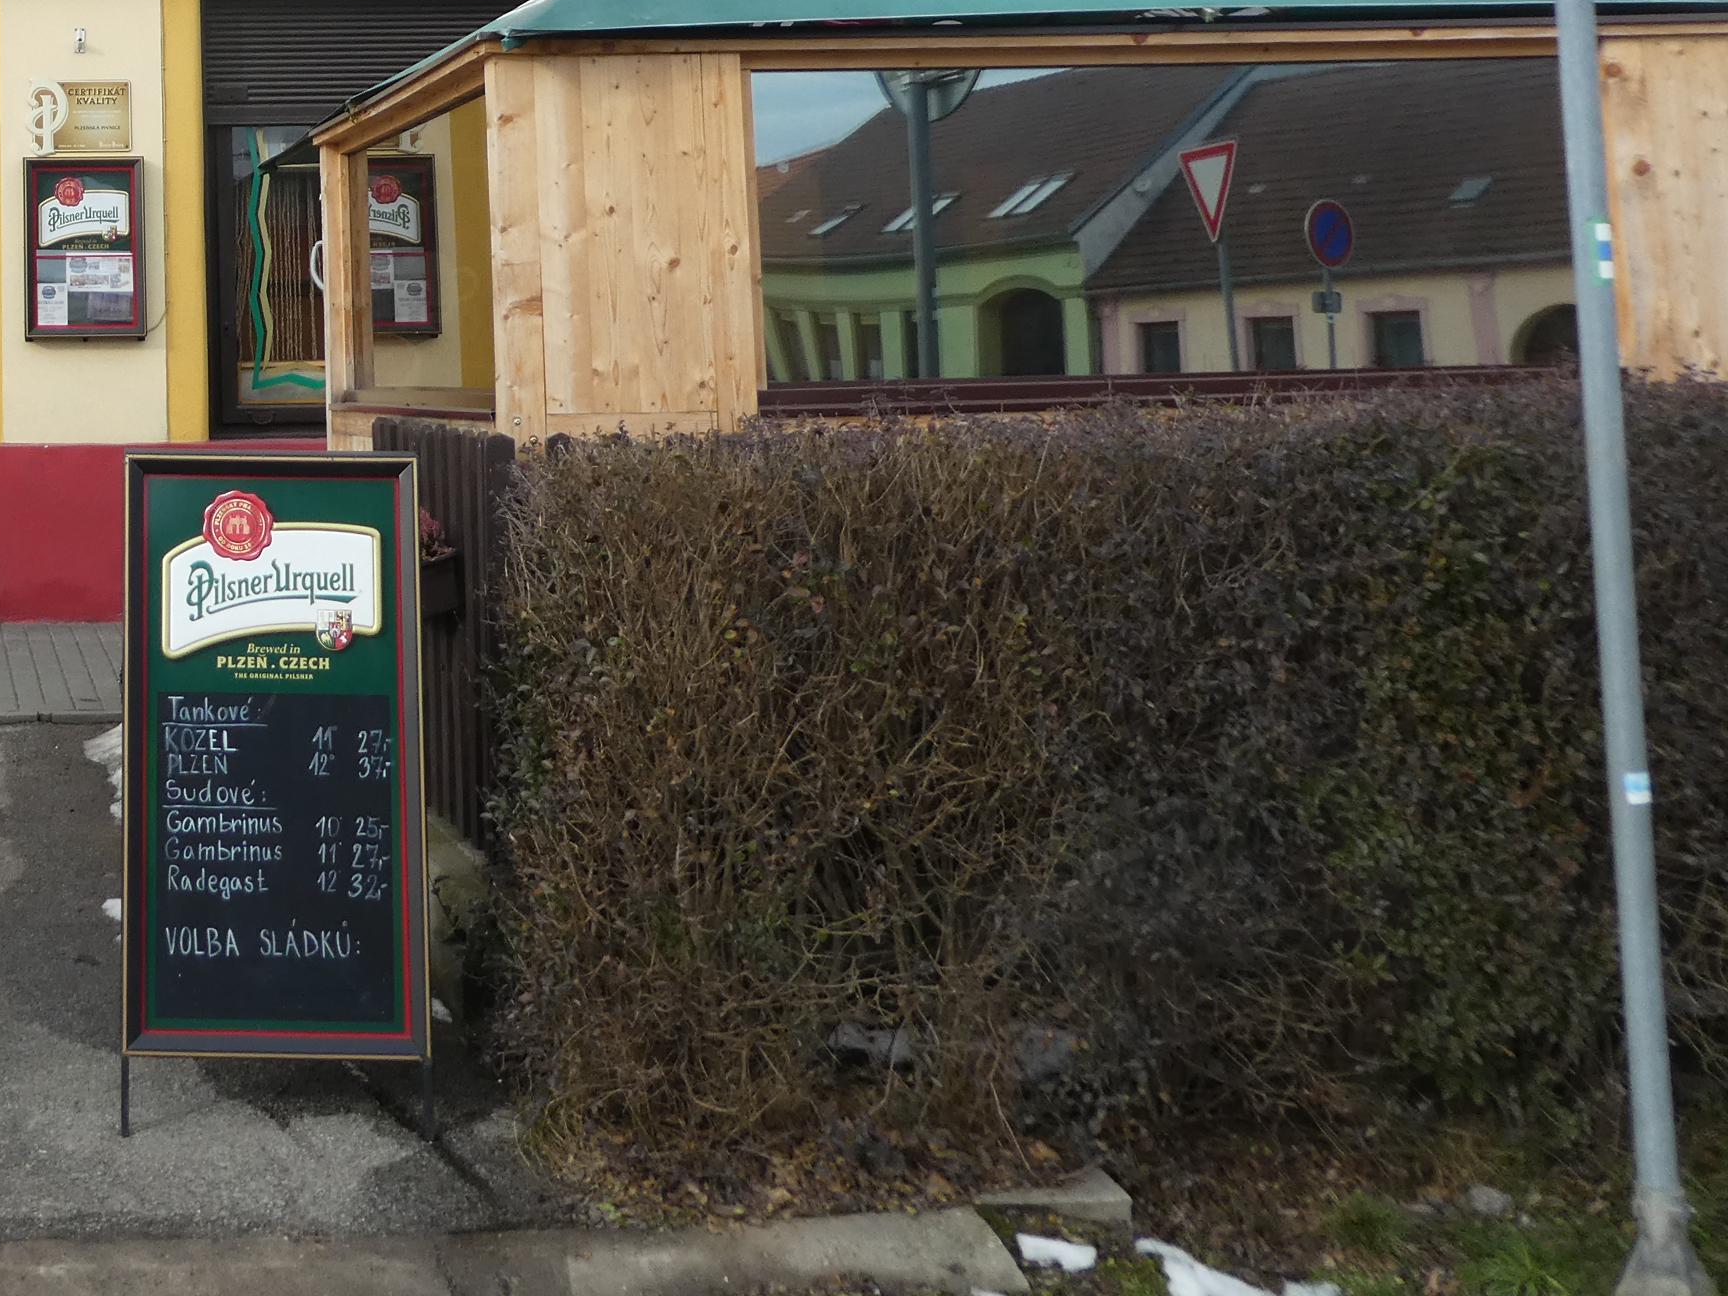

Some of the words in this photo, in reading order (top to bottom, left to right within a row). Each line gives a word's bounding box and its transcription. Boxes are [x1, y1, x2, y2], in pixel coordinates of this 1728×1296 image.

[68, 87, 127, 96] CERTIFIKÁT
[76, 97, 118, 105] KVALITY
[47, 206, 85, 233] Pilsner
[83, 206, 119, 224] Urquell
[186, 560, 272, 622] Pilsner
[272, 558, 355, 606] Urquell
[246, 642, 288, 654] Brewed
[289, 643, 301, 654] in
[216, 653, 268, 669] PLZEŇ
[278, 656, 330, 670] CZECH
[249, 672, 284, 680] ORIGINAL
[164, 726, 239, 752] KOZEL
[166, 809, 283, 836] Gambrinus
[355, 816, 390, 840] 25,-
[164, 836, 283, 862] Gambrinus
[351, 843, 391, 870] 27,-
[167, 864, 270, 900] Radegast
[165, 926, 240, 957] VOLBA
